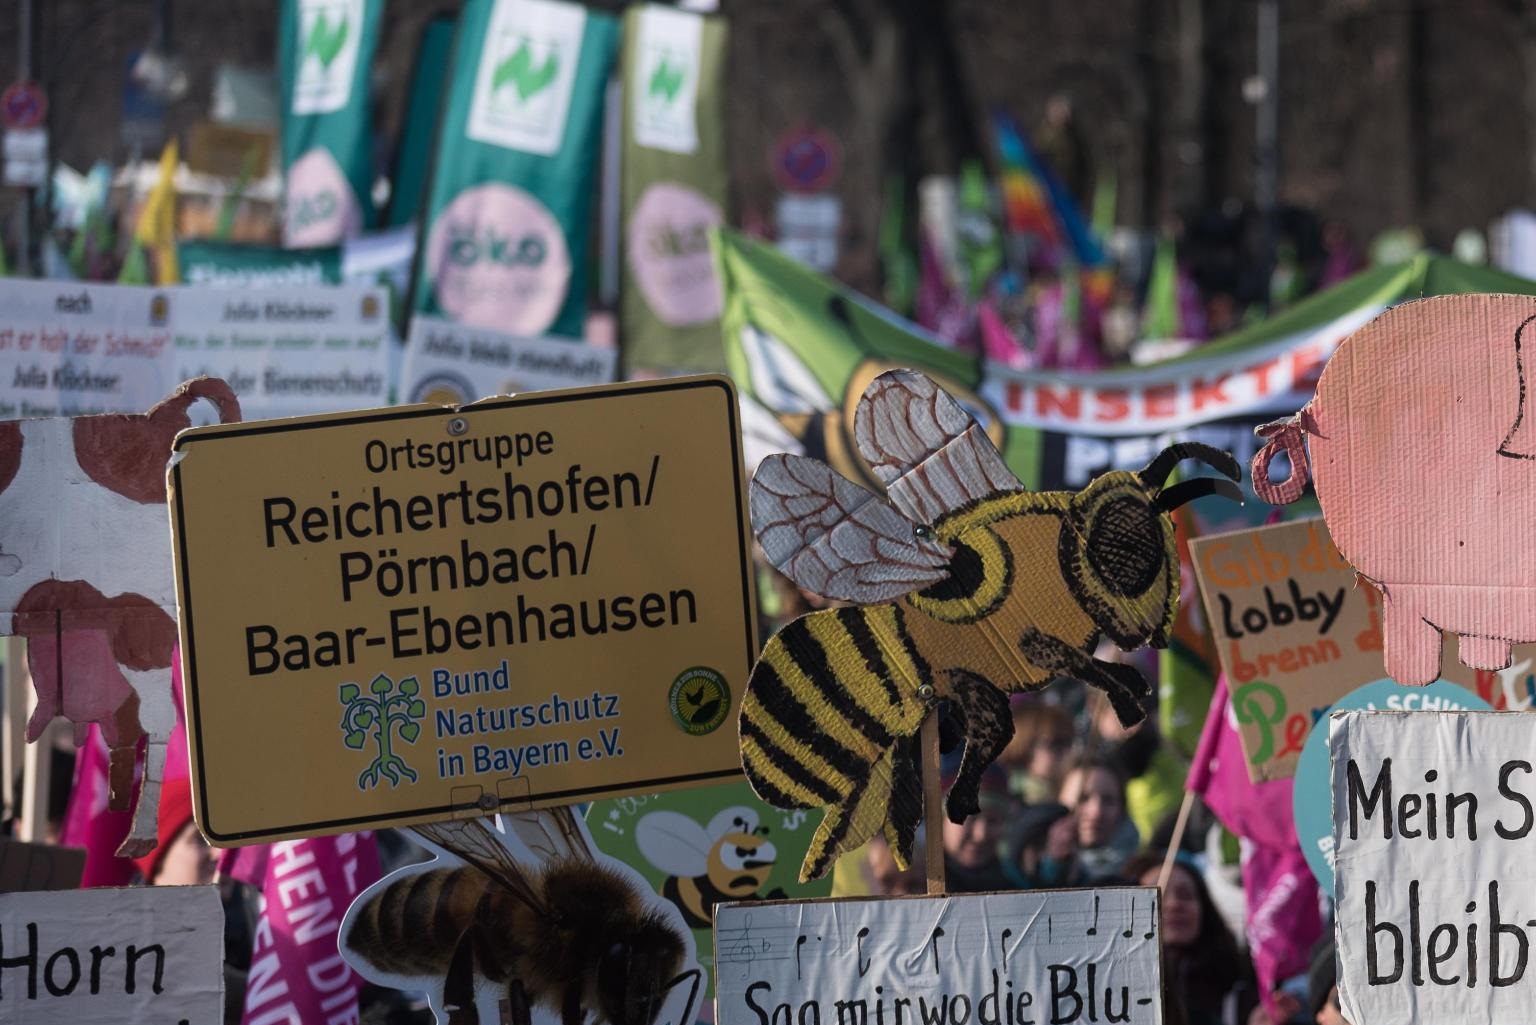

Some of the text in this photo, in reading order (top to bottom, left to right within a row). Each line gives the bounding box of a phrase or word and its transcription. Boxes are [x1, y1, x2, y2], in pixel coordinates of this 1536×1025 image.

[365, 430, 554, 475] Ortsgruppe
[263, 455, 661, 548] Reichertshofen/
[340, 524, 597, 602] Pörnbach/
[1203, 531, 1292, 588] Gib
[245, 588, 698, 677] Baar-Ebenhausen
[1218, 577, 1345, 639] lobby
[432, 660, 510, 699] Bund
[1230, 637, 1341, 683] brenn
[436, 691, 620, 738] Naturschutz
[438, 728, 625, 780] in Bayern e.V.
[1346, 757, 1478, 842] Mein
[0, 922, 166, 1000] Horn
[1047, 963, 1154, 1025] Blu-
